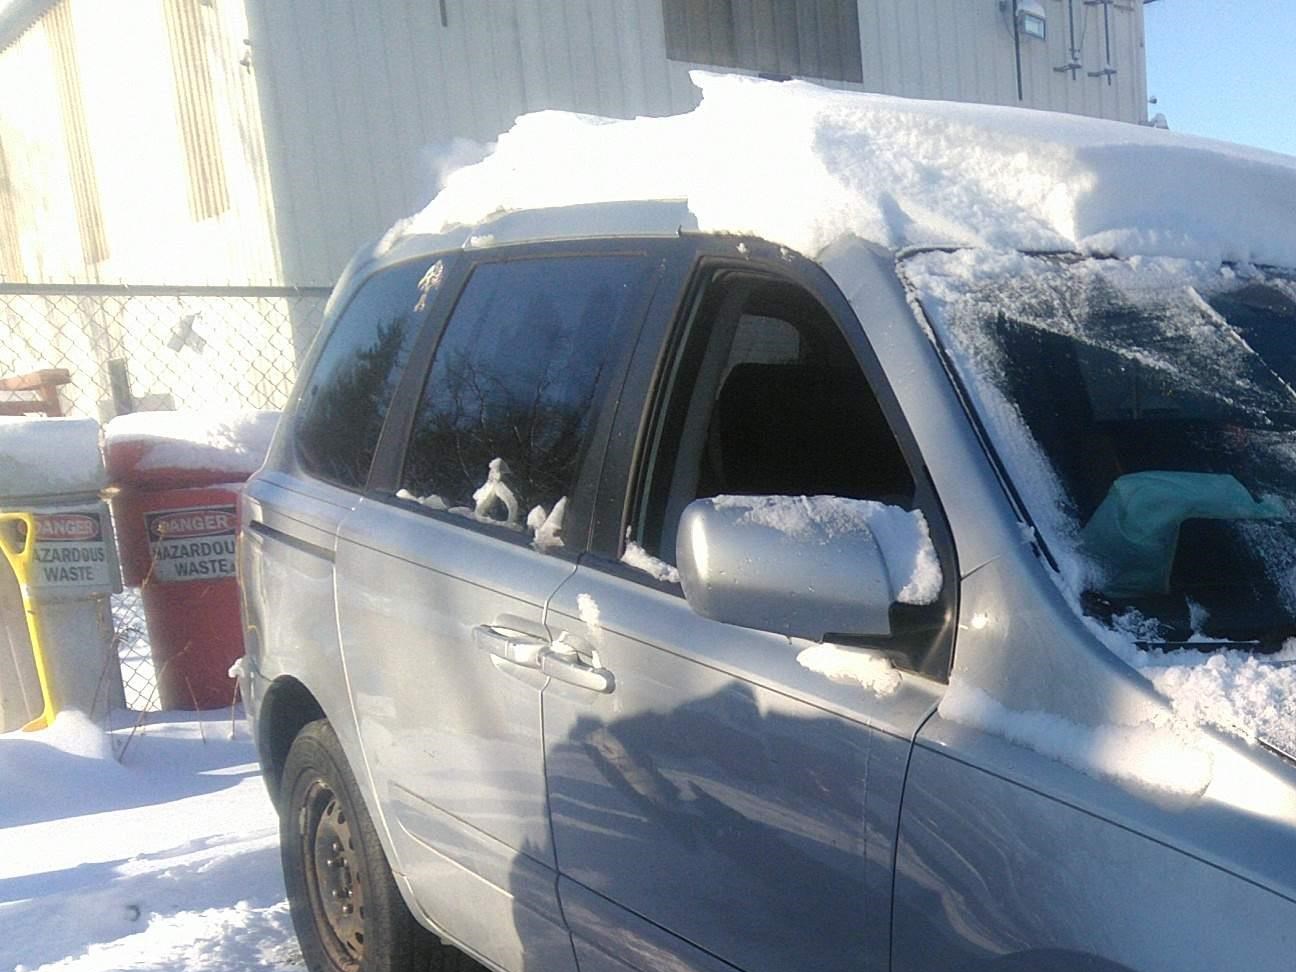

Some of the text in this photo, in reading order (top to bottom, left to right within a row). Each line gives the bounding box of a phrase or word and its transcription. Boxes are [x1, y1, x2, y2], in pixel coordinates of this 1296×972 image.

[33, 547, 105, 562] AZARDOUS
[153, 541, 236, 561] HAZARDOU
[44, 566, 95, 582] WASTE
[174, 559, 229, 577] WASTE
